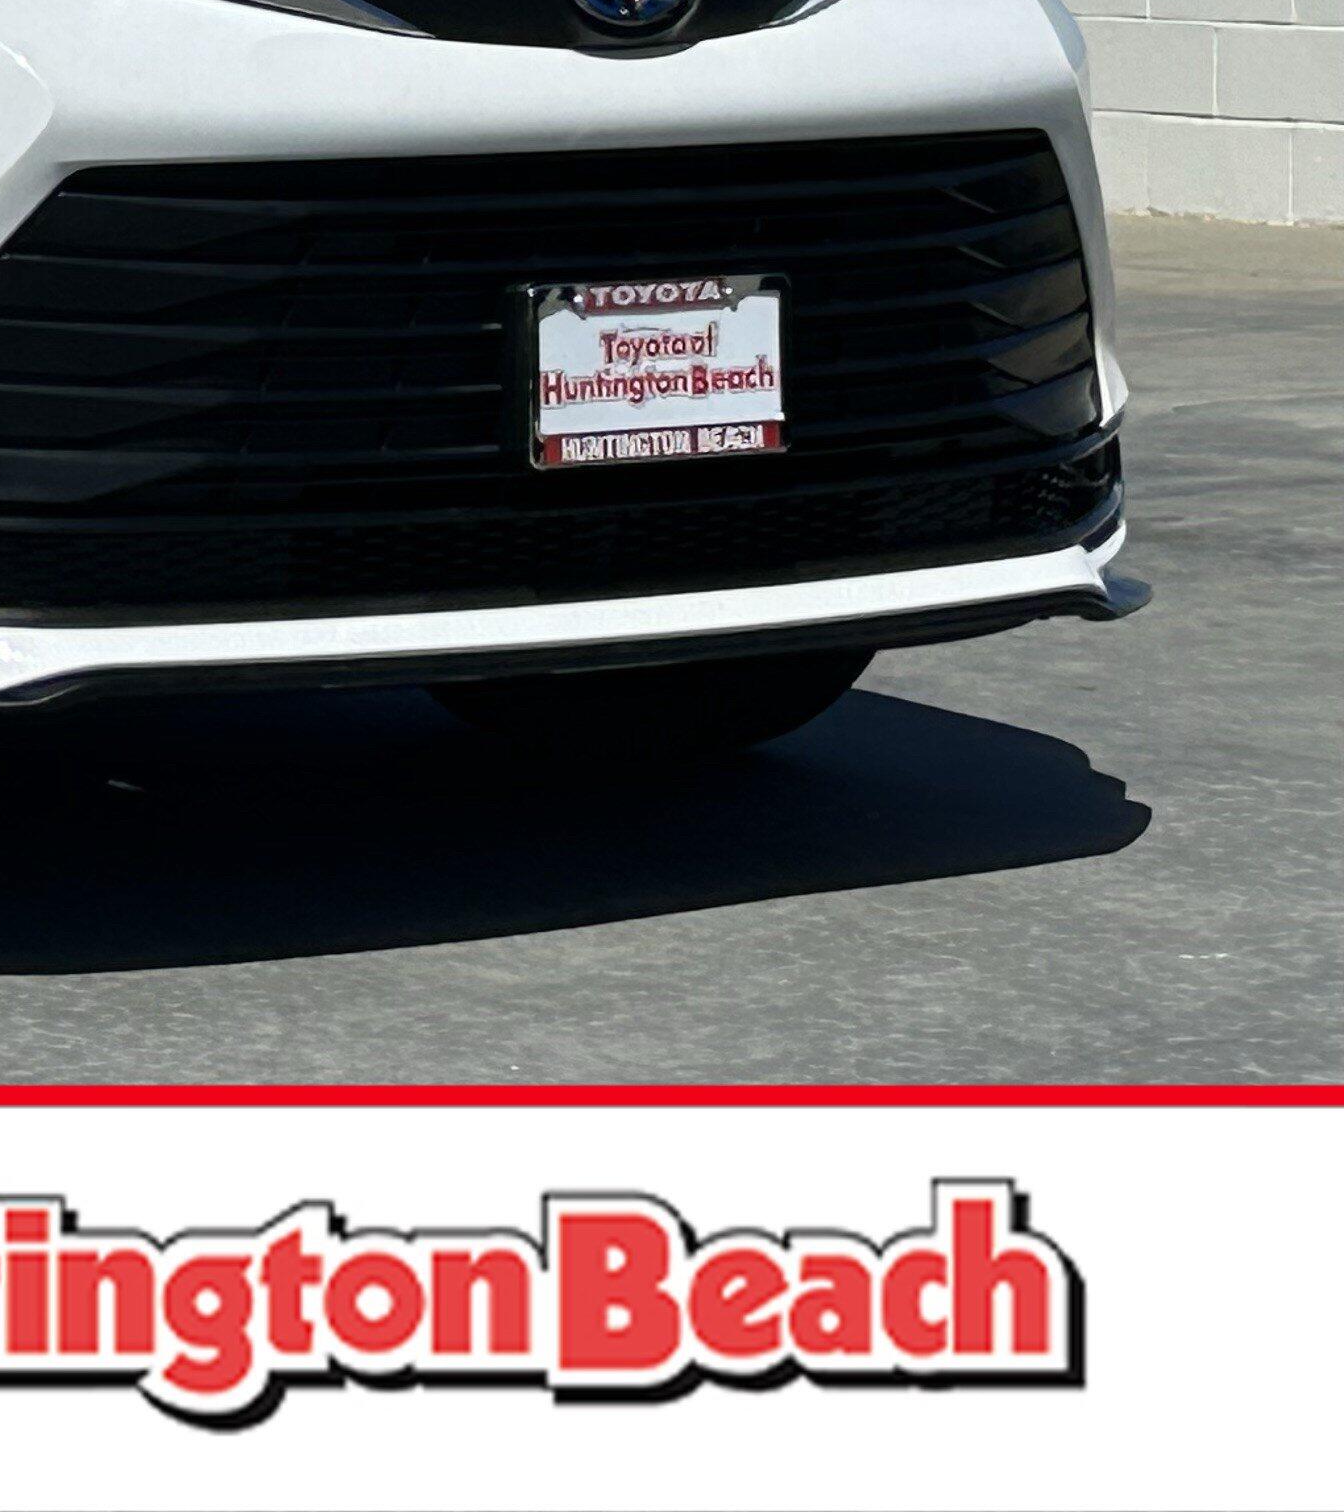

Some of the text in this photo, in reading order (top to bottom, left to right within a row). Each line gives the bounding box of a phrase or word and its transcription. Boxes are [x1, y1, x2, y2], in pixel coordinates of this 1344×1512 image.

[588, 280, 721, 308] TOYOTA
[599, 321, 717, 366] Toyota of
[541, 354, 775, 406] Huntington Beach
[561, 425, 765, 462] HUNTINGTON BEACH
